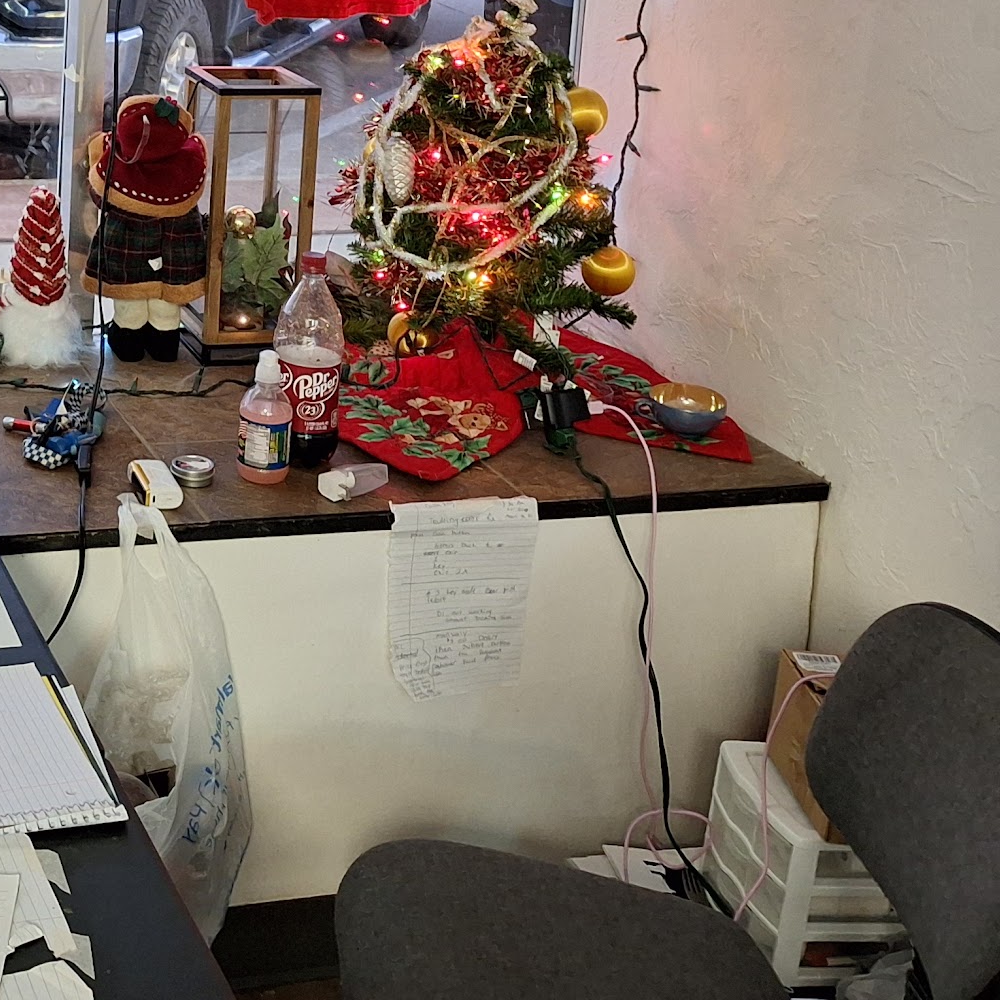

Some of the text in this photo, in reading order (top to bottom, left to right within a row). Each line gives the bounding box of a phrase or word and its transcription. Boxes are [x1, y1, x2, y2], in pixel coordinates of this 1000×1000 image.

[312, 371, 331, 385] Dr
[293, 374, 338, 400] Pepper
[304, 404, 317, 416] 23
